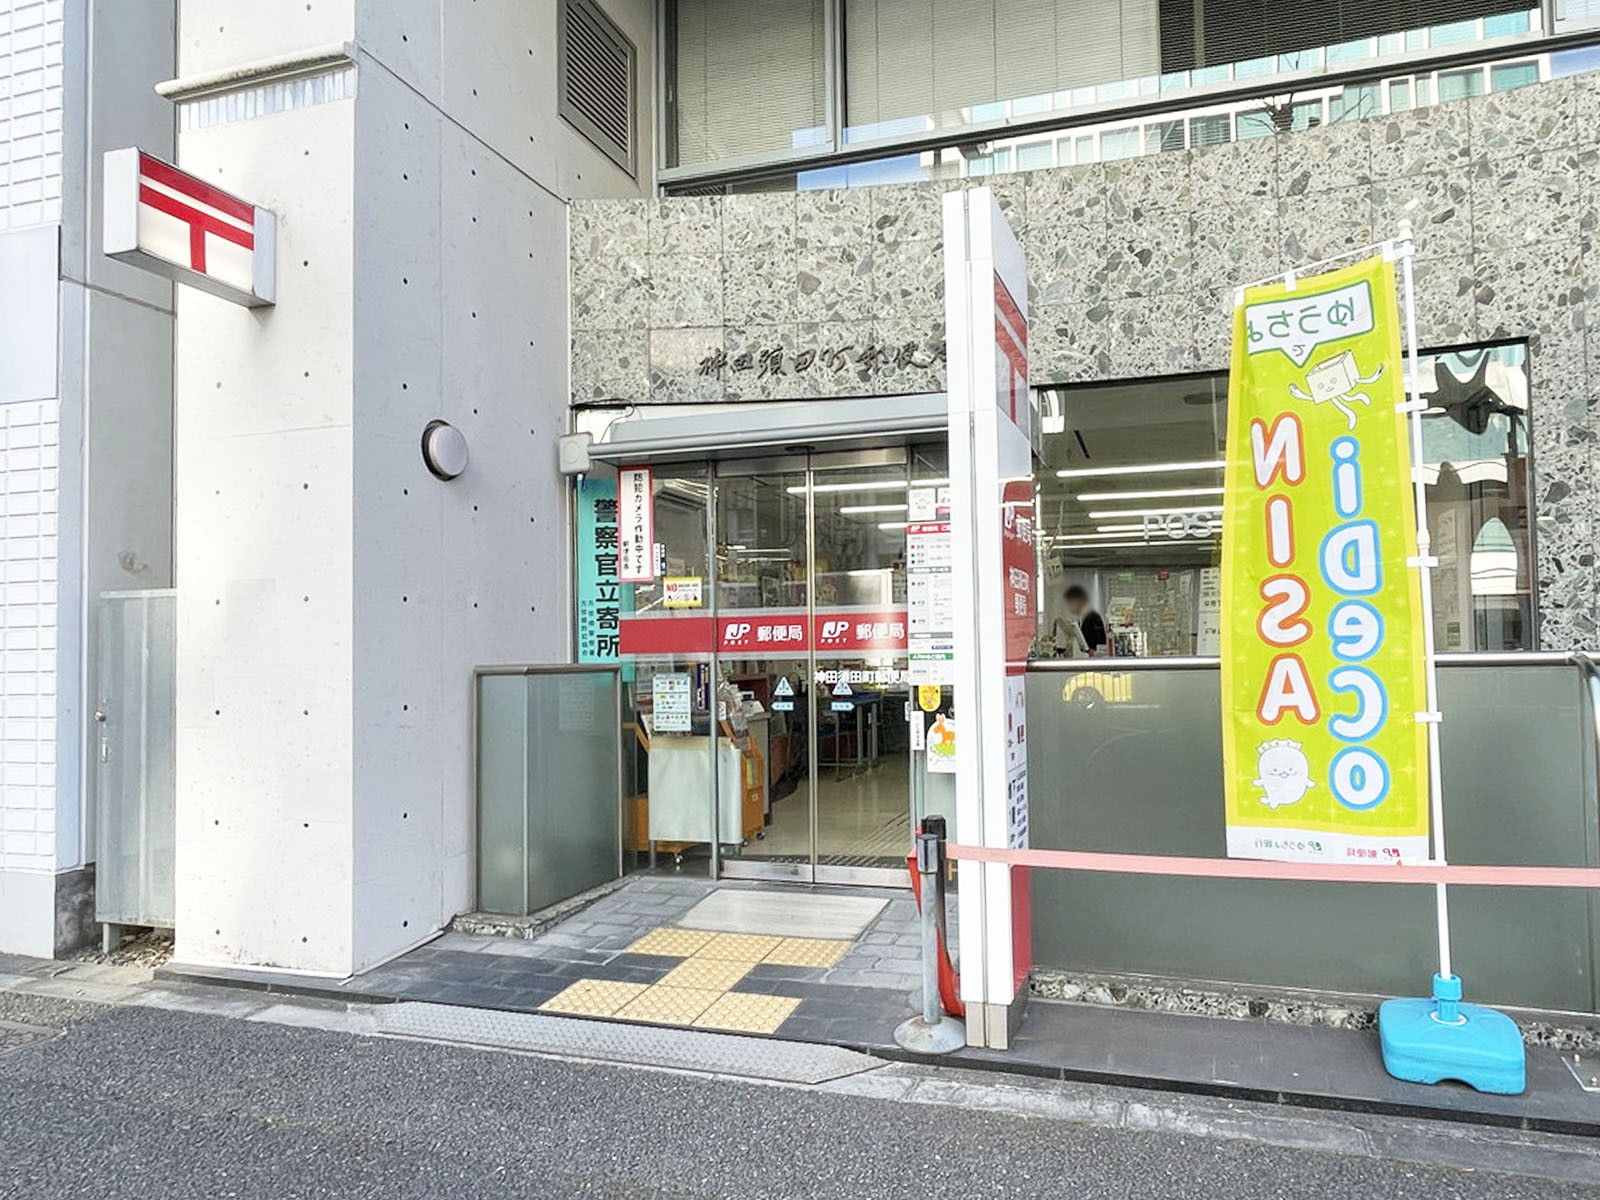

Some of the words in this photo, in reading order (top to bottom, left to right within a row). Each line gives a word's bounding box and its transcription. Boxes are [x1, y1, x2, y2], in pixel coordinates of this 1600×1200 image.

[594, 498, 620, 658] 警察官立寄所
[757, 625, 803, 642] 郵便局
[856, 622, 905, 640] 郵便局
